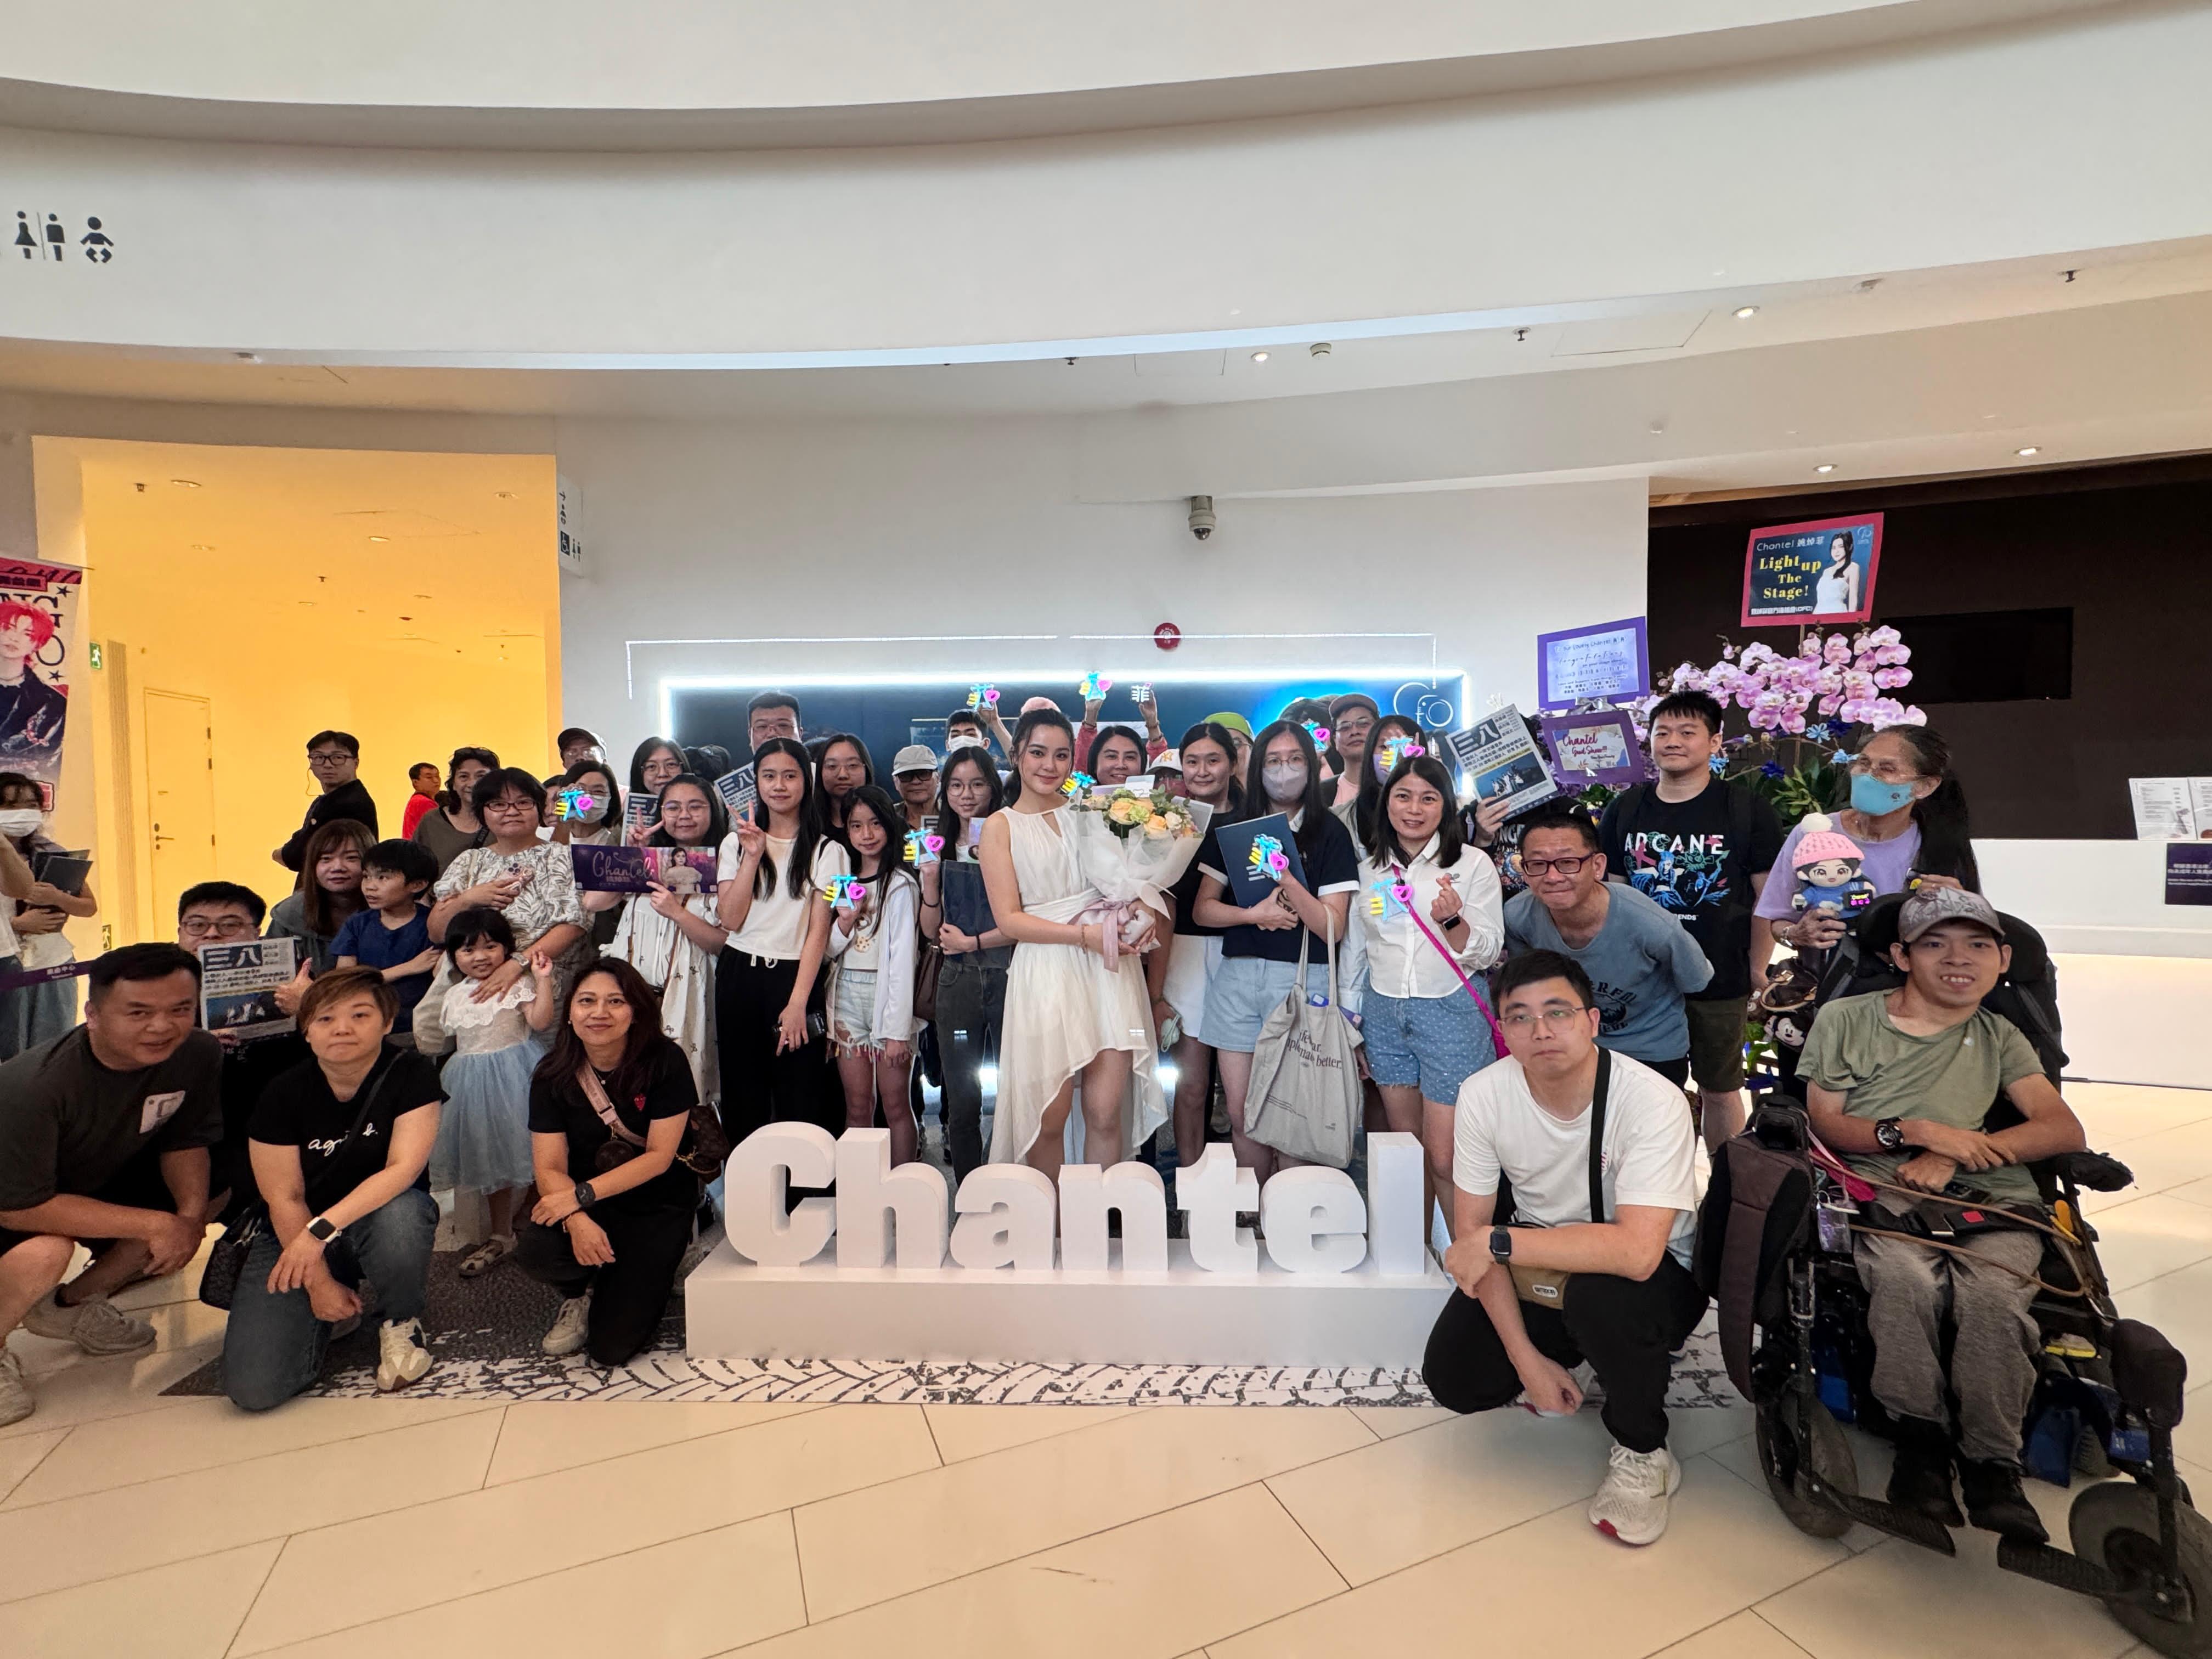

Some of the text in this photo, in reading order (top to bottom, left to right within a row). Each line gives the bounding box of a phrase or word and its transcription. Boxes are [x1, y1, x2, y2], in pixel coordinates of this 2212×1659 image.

[1757, 539, 1794, 551] Chantel
[1759, 555, 1821, 574] Light up
[1778, 573, 1802, 584] The
[1763, 585, 1809, 601] Stage!
[1454, 724, 1499, 755] 三八
[1563, 732, 1598, 746] Chantel
[721, 768, 754, 795] 三八
[1624, 832, 1724, 855] ARCANE
[593, 851, 654, 878] Chantel
[206, 947, 261, 969] 三八
[1317, 1054, 1342, 1069] better.
[724, 1121, 1425, 1274] Chantel
